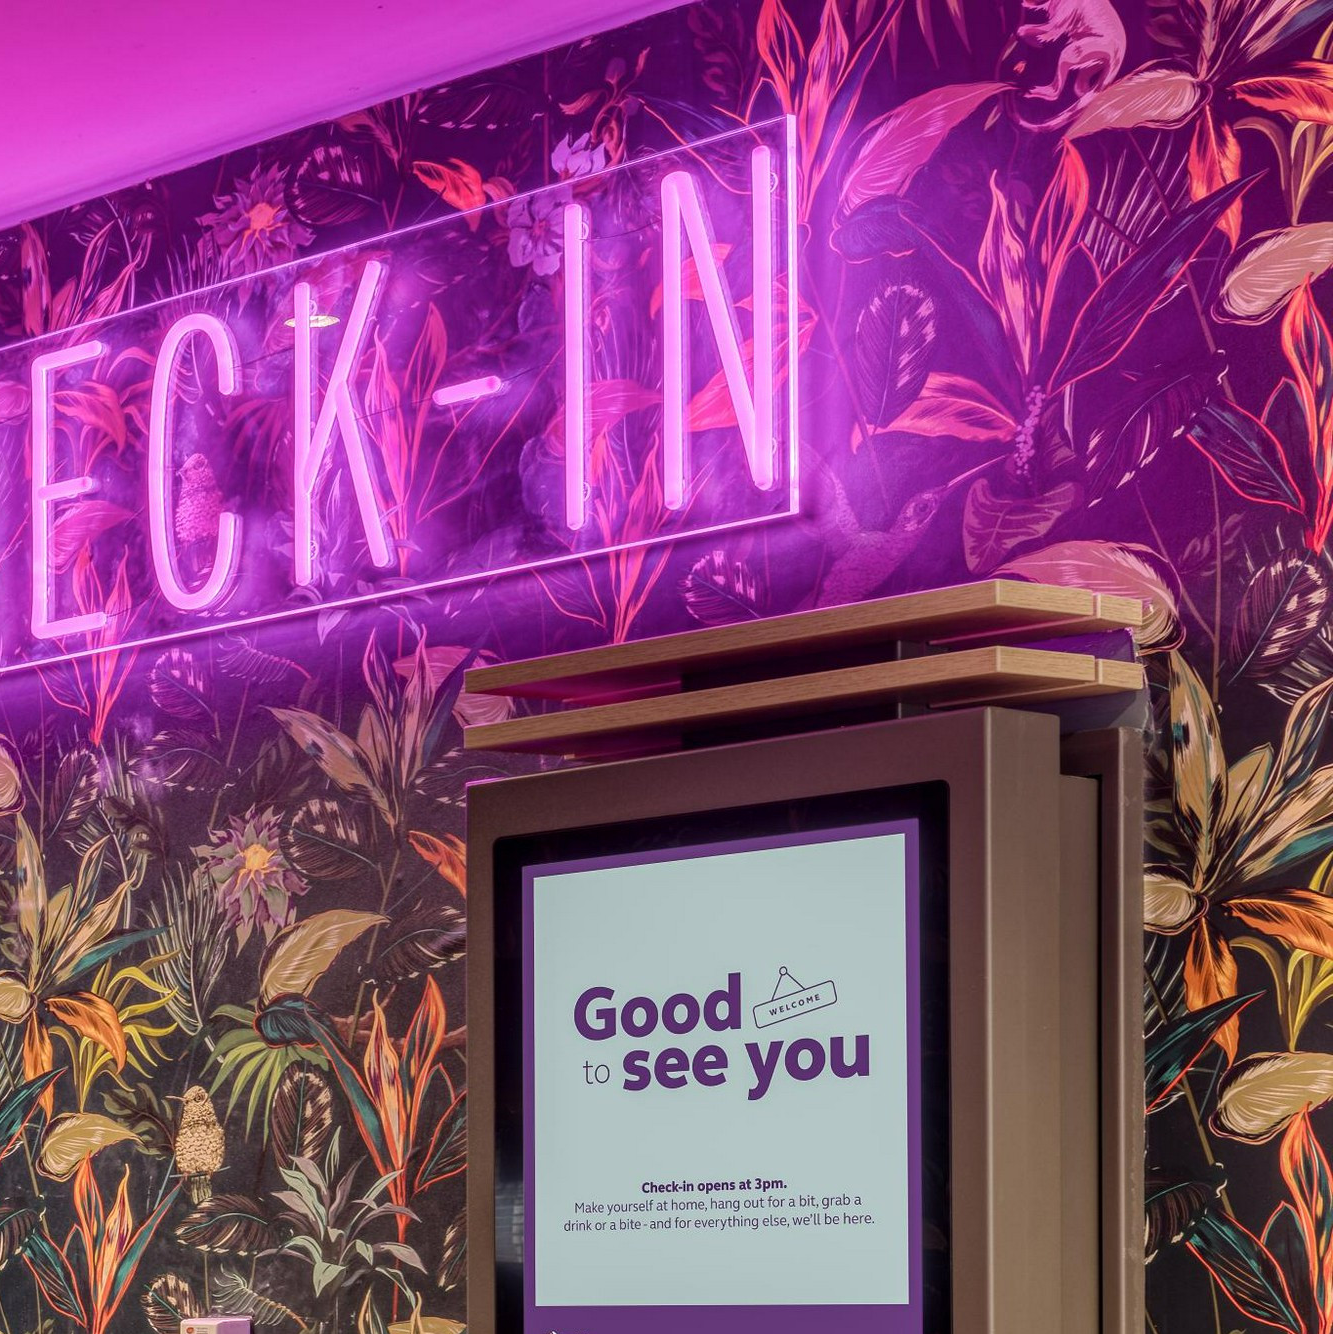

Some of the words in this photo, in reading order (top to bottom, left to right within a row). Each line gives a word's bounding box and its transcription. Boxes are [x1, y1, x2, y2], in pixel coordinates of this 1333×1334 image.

[574, 972, 742, 1041] Good
[769, 993, 821, 1017] WELCOME
[583, 1060, 611, 1085] to
[623, 1045, 729, 1092] see
[745, 1034, 870, 1101] you
[641, 1181, 694, 1193] Check-in
[697, 1182, 735, 1194] opens
[739, 1179, 751, 1190] at
[755, 1178, 787, 1192] 3pm.
[575, 1202, 604, 1213] Make
[607, 1200, 654, 1215] yourself
[656, 1201, 668, 1211] at
[671, 1200, 707, 1211] home,
[710, 1198, 740, 1212] hang
[743, 1198, 765, 1208] out
[767, 1196, 785, 1207] for
[788, 1198, 796, 1207] a
[799, 1195, 819, 1208] bit,
[821, 1194, 851, 1209] grab
[854, 1196, 863, 1205] a
[563, 1220, 592, 1231] drink
[594, 1222, 607, 1230] or
[609, 1222, 617, 1230] a
[619, 1219, 641, 1230] bite
[649, 1217, 671, 1229] and
[674, 1217, 691, 1228] for
[694, 1216, 759, 1230] everything
[762, 1215, 789, 1227] else,
[824, 1213, 839, 1224] be
[843, 1213, 874, 1224] here.
